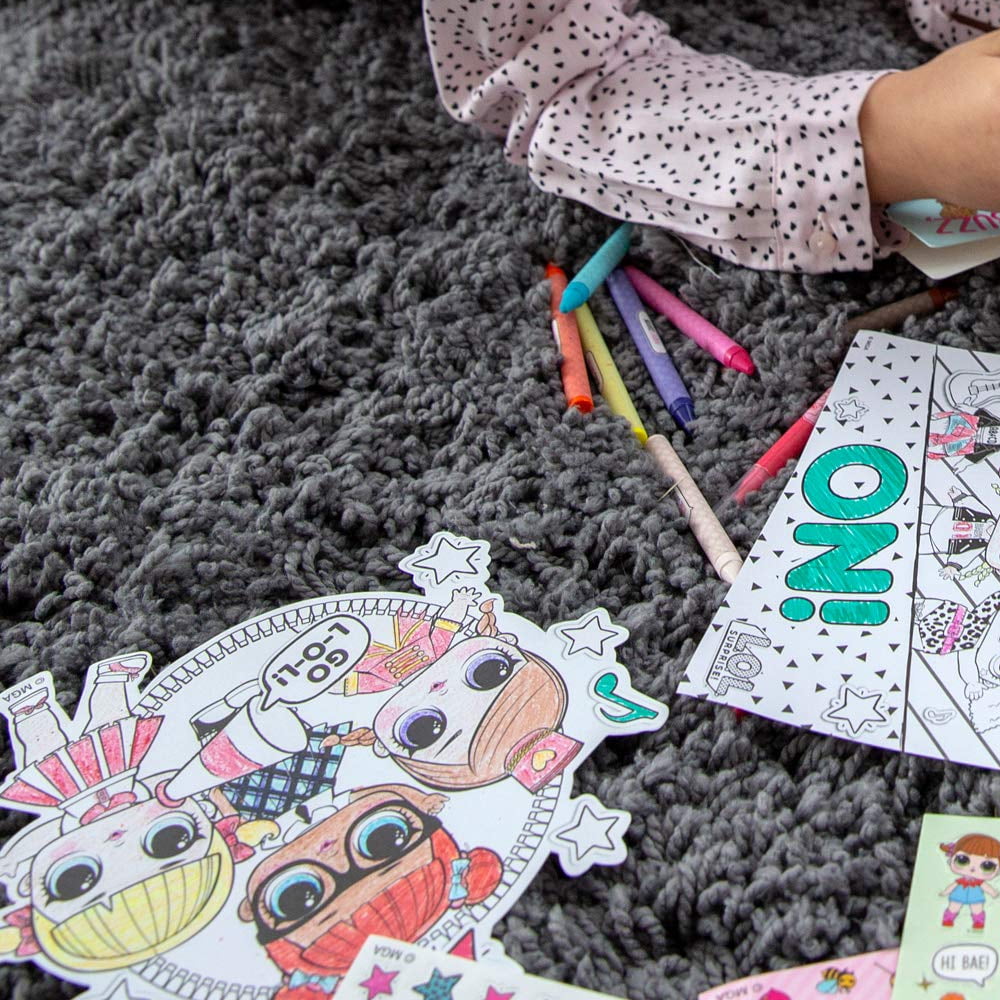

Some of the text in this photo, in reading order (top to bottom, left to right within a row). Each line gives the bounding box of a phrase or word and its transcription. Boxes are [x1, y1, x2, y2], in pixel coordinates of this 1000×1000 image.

[779, 443, 909, 626] ON!
[271, 622, 350, 687] L-O-L!
[307, 648, 349, 683] GO
[710, 629, 739, 682] SURPRISE!
[2, 684, 32, 702] MGA
[374, 944, 402, 961] MGA
[941, 954, 989, 970] HI BAE!
